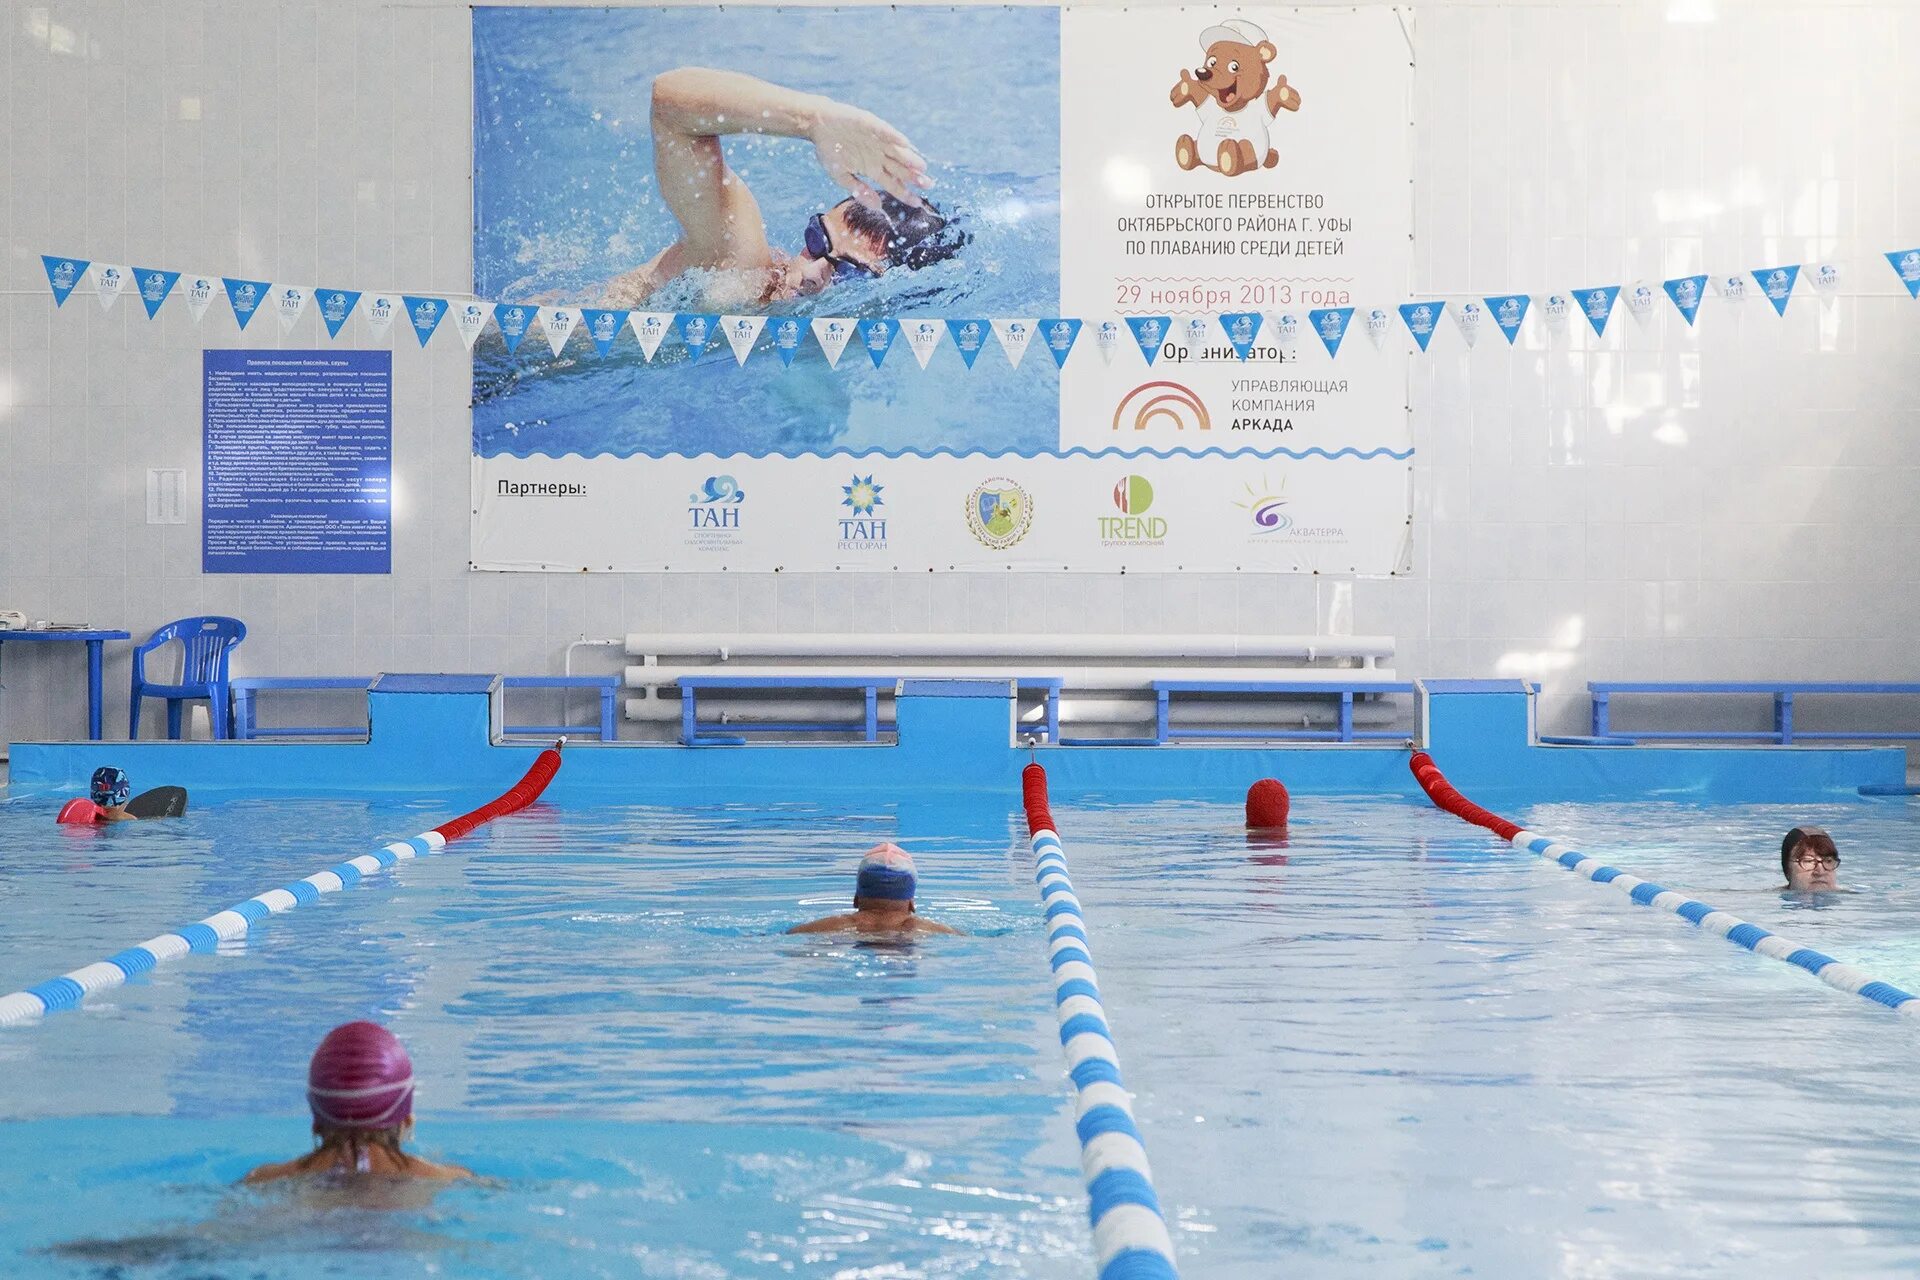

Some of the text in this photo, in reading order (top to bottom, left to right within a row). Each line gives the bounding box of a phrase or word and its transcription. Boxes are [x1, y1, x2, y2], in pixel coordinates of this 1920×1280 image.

[1145, 194, 1324, 210] ОТКРЫТОЕ ПЕРВЕНСТВО
[1117, 214, 1352, 232] ОКТЯБРЬСКОГО РАЙОНА Г. УФЫ
[1126, 238, 1344, 258] ПО ПЛАВАНИЮ СРЕДИ ДЕТЕЙ
[99, 279, 118, 288] ТАН
[190, 291, 208, 299] ТАН
[1117, 285, 1350, 308] 29 ноября 2013 года
[280, 299, 299, 308] ТАН
[370, 308, 389, 318] ТАН
[460, 315, 480, 325] ТАН
[1367, 320, 1386, 329] ТАН
[549, 321, 568, 330] ТАН
[1277, 325, 1296, 334] ТАН
[641, 327, 659, 336] ТАН
[733, 330, 752, 339] ТАН
[1097, 331, 1116, 340] ТАН
[1186, 329, 1205, 338] ТАН
[824, 332, 843, 341] ТАН
[914, 333, 933, 342] ТАН
[1005, 332, 1024, 342] ТАН
[1231, 380, 1348, 394] УПРАВЛЯЮЩАЯ
[1232, 400, 1315, 412] КОМПАНИЯ
[1231, 418, 1294, 432] АРКАДА
[498, 480, 587, 497] Партнеры:
[688, 508, 740, 528] ТАН
[839, 522, 888, 539] ТАН
[1098, 518, 1168, 538] TREND
[1290, 528, 1344, 536] АКВАТЕРРА
[838, 542, 887, 550] РЕСТОРАН
[1102, 540, 1126, 548] группа
